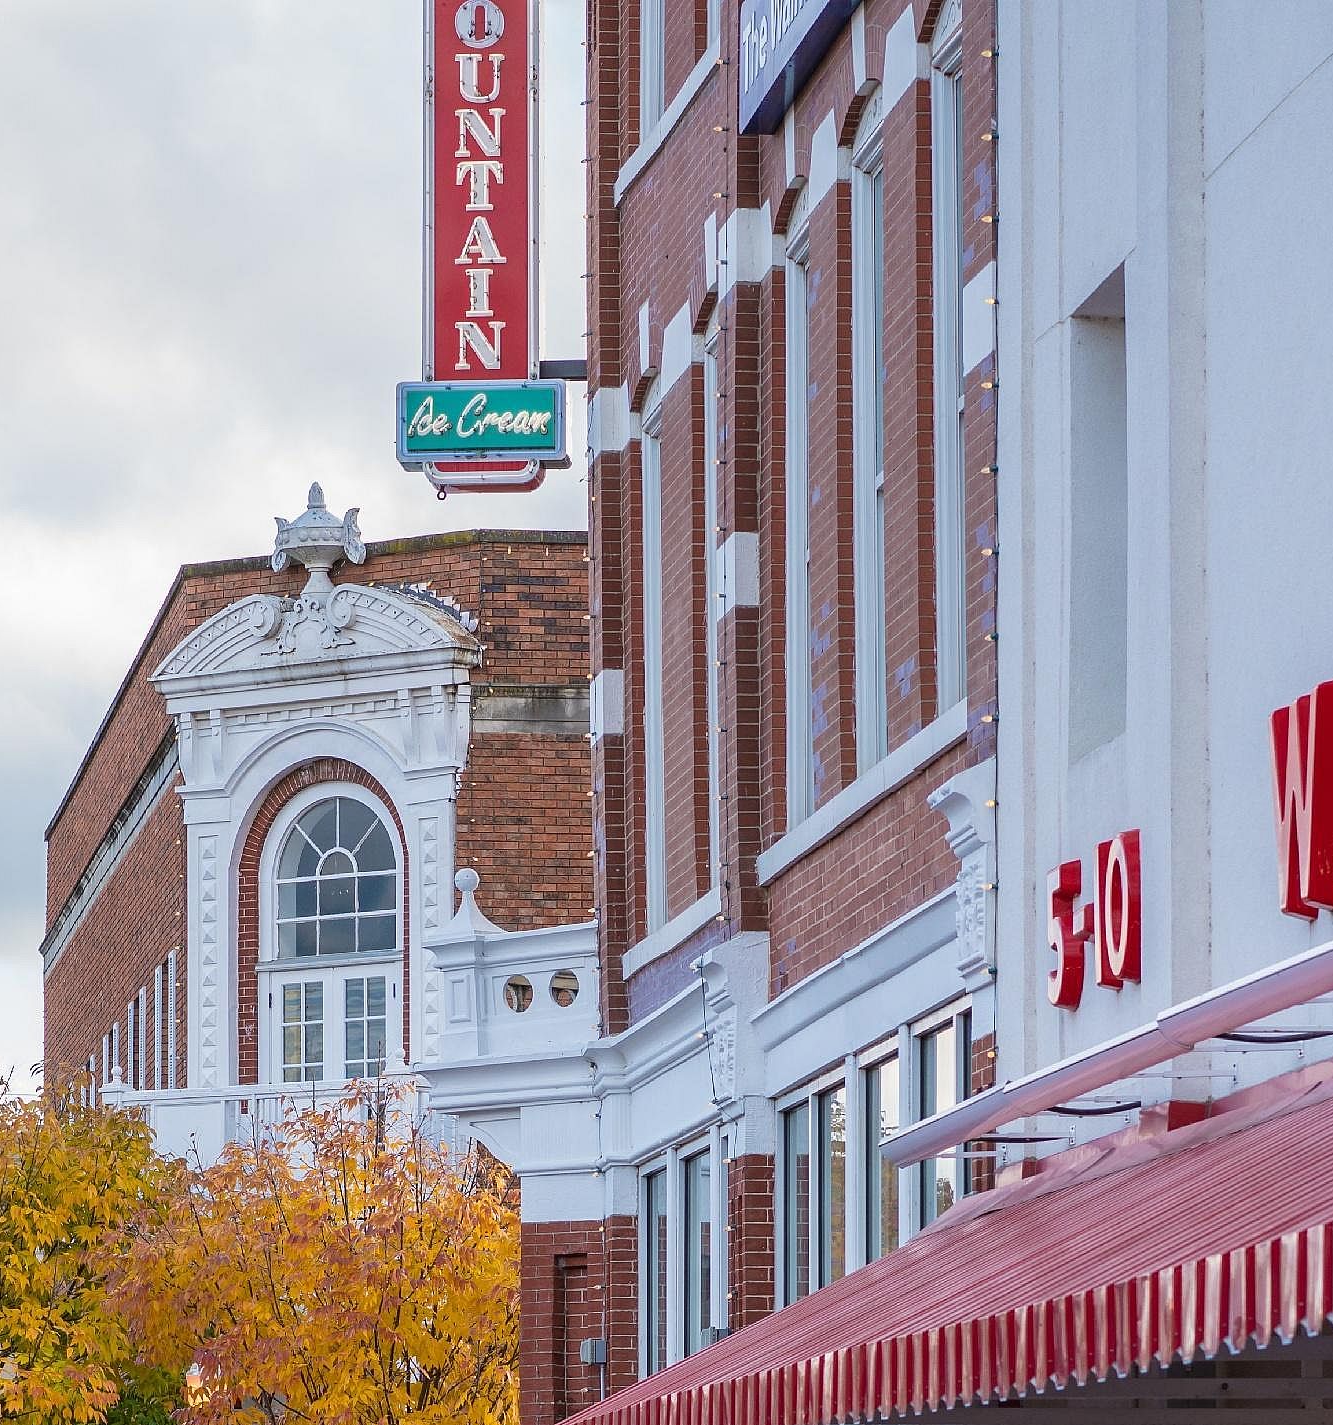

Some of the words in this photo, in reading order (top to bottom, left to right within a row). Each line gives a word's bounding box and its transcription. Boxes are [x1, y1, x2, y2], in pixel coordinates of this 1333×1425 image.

[743, 10, 768, 95] The
[457, 393, 552, 438] Cream
[1046, 828, 1142, 1013] 5-10
